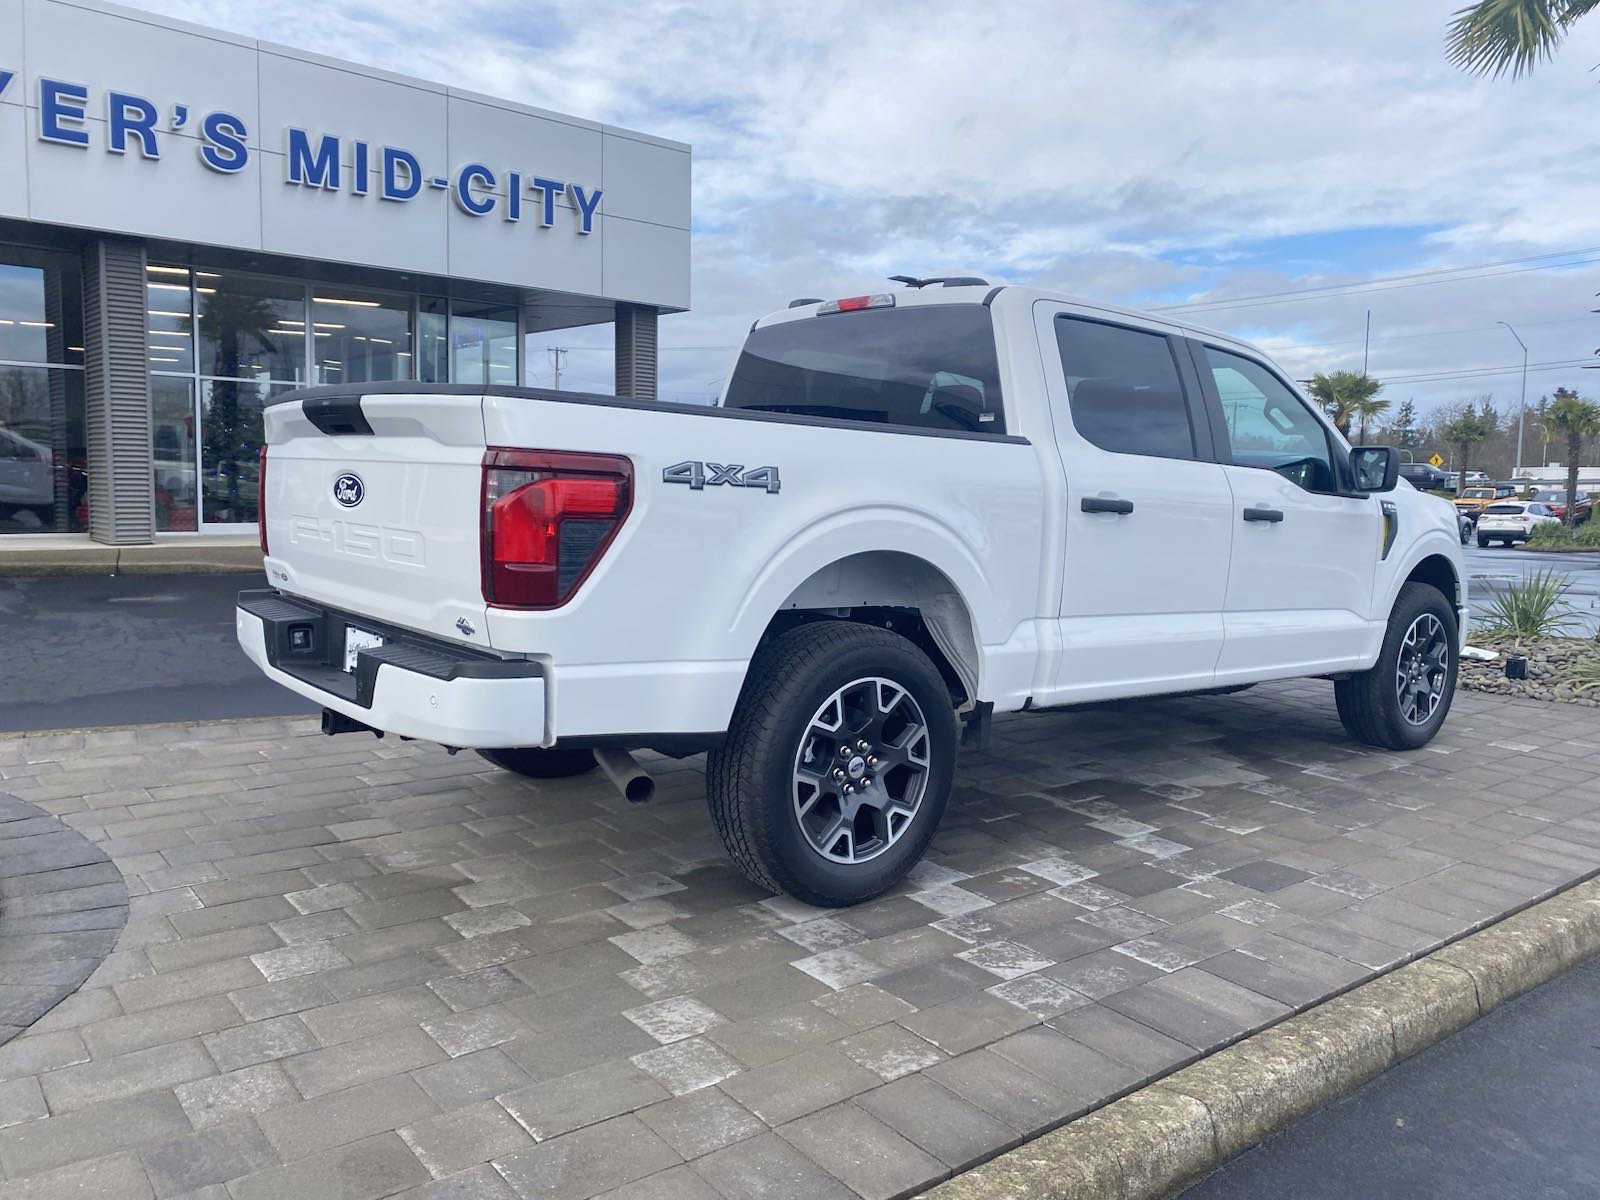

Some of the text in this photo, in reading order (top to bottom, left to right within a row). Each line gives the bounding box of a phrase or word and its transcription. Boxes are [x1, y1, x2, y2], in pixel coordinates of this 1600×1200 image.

[0, 69, 605, 235] ER'S MID-CITY
[337, 478, 358, 501] Ford
[289, 513, 426, 568] F-150
